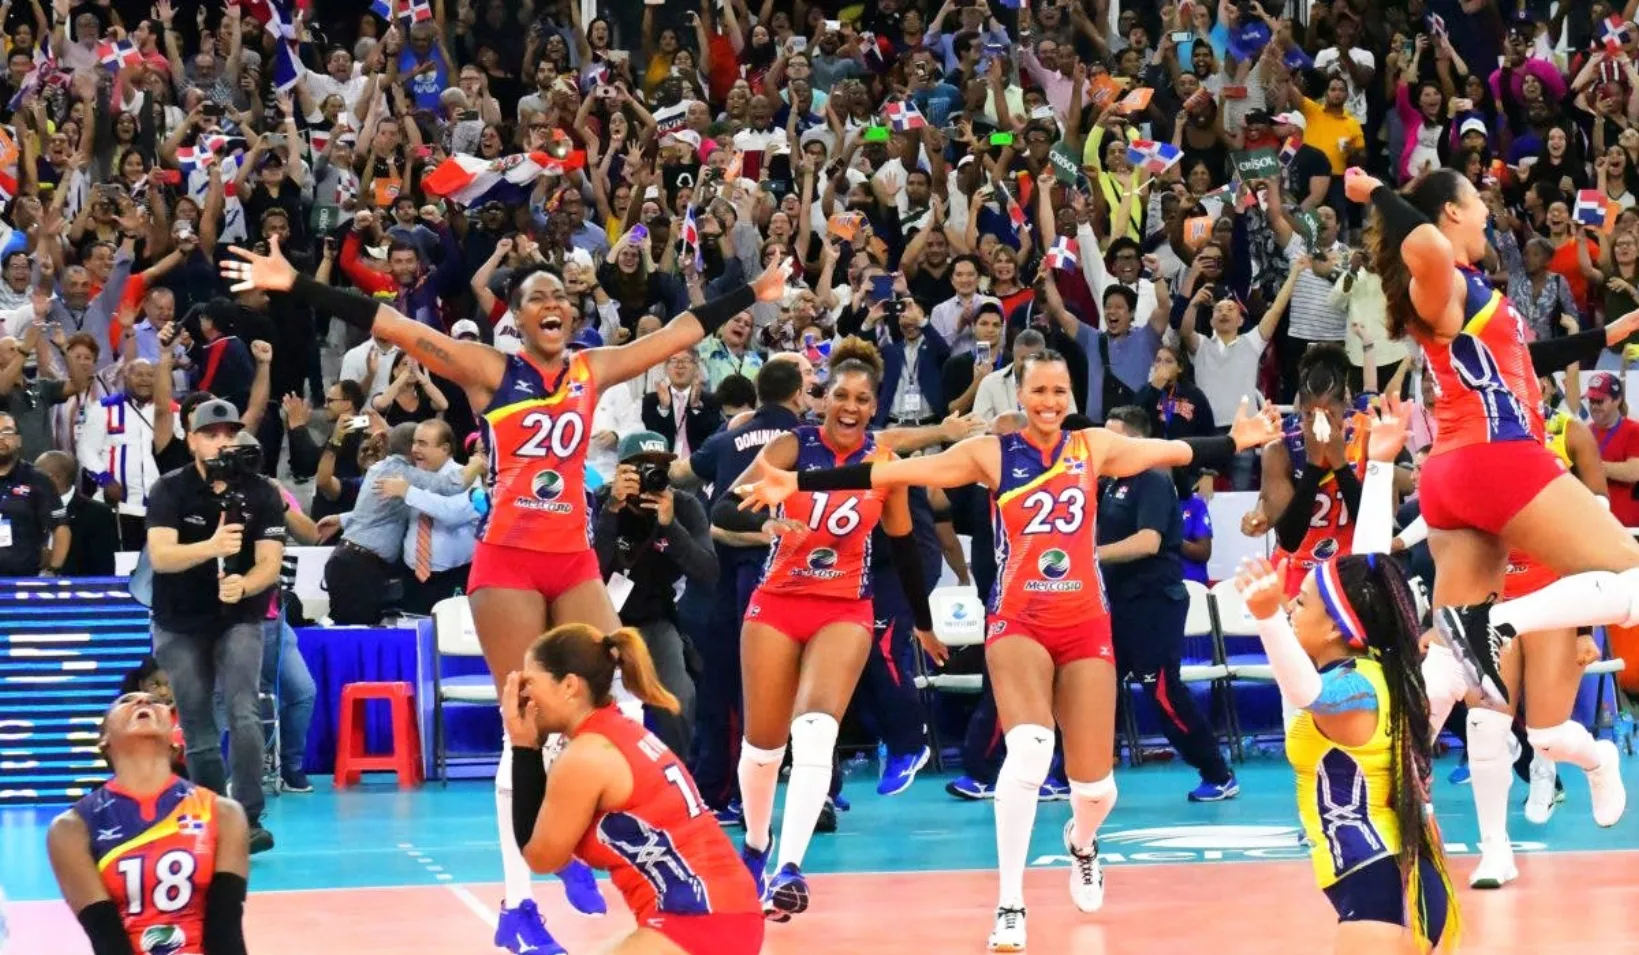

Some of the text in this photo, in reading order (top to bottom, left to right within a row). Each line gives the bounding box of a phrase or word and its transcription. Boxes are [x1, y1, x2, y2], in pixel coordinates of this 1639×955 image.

[514, 411, 584, 458] 20
[638, 440, 666, 451] VANS
[809, 491, 860, 536] 16
[1022, 487, 1085, 534] 23
[117, 850, 196, 914] 18
